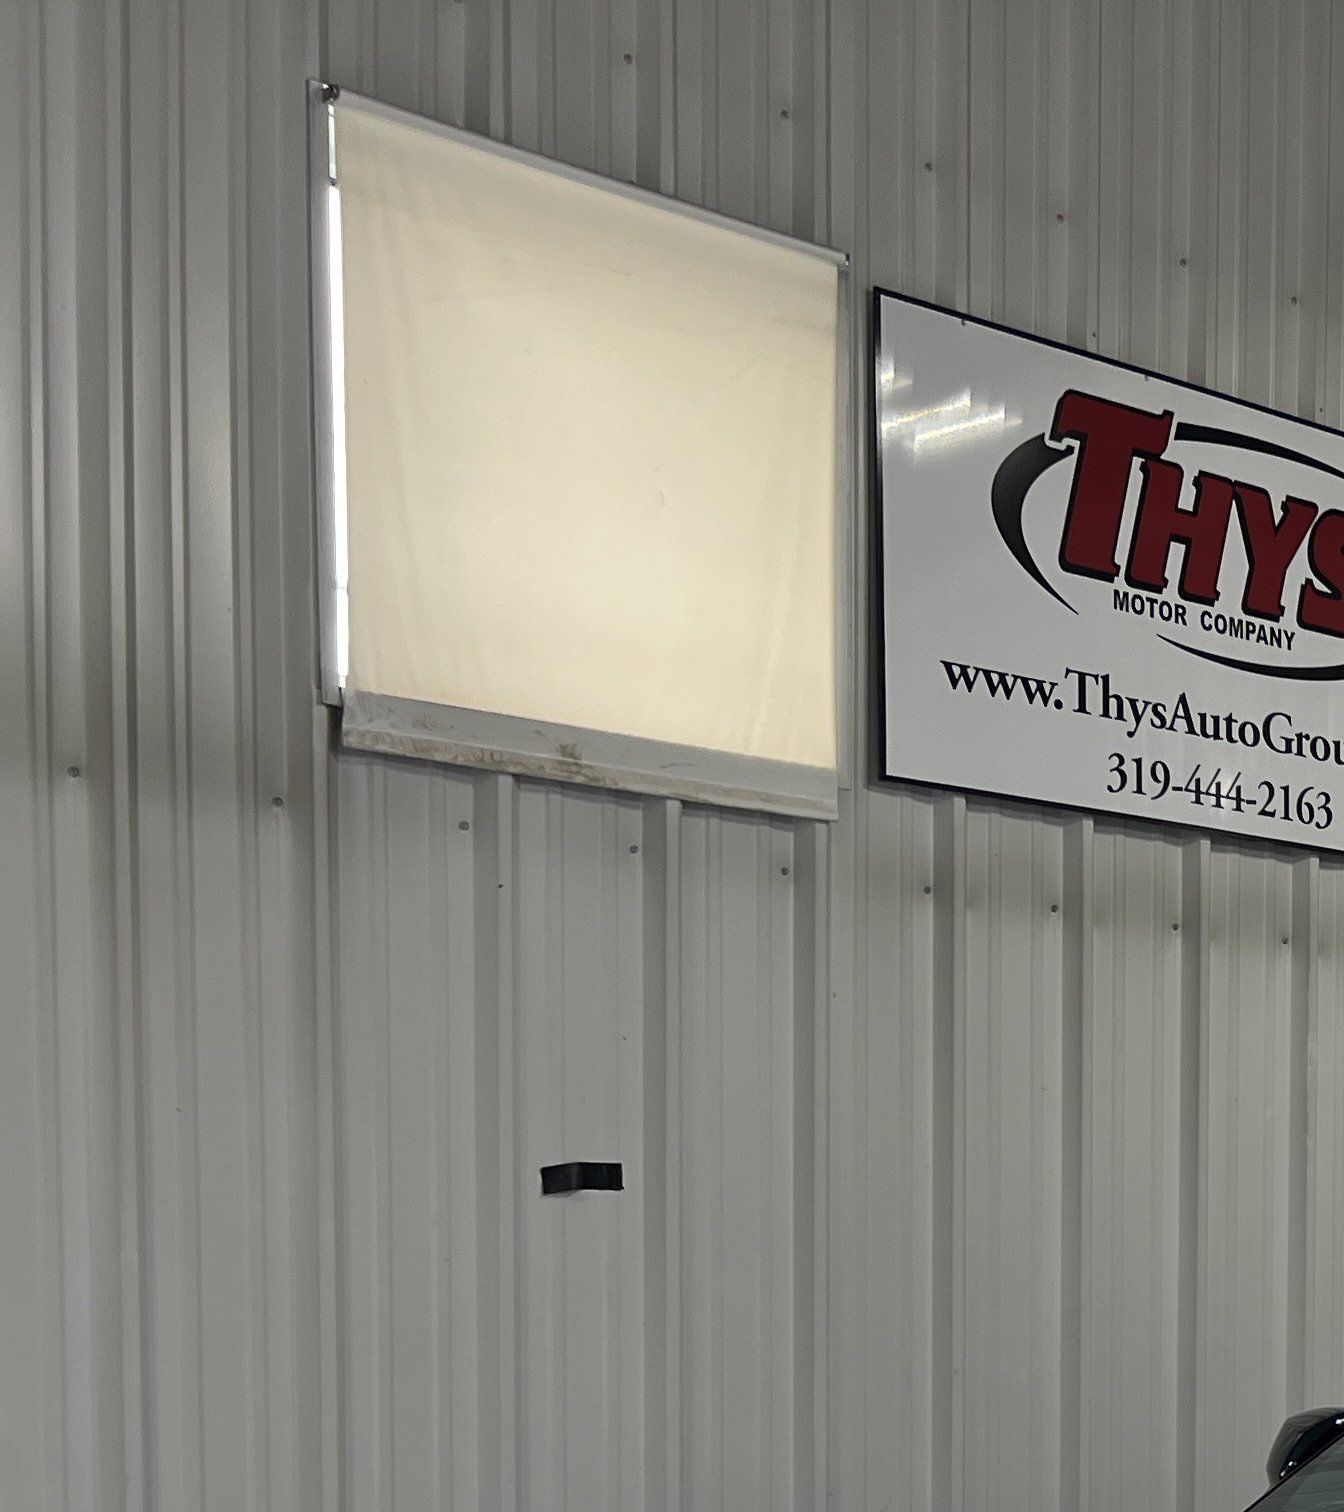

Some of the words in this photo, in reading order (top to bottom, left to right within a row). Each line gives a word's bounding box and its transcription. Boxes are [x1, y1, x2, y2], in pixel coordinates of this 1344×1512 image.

[1113, 590, 1188, 627] MOTOR
[1200, 611, 1296, 652] COMPANY
[1106, 753, 1333, 830] 319-444-2163
